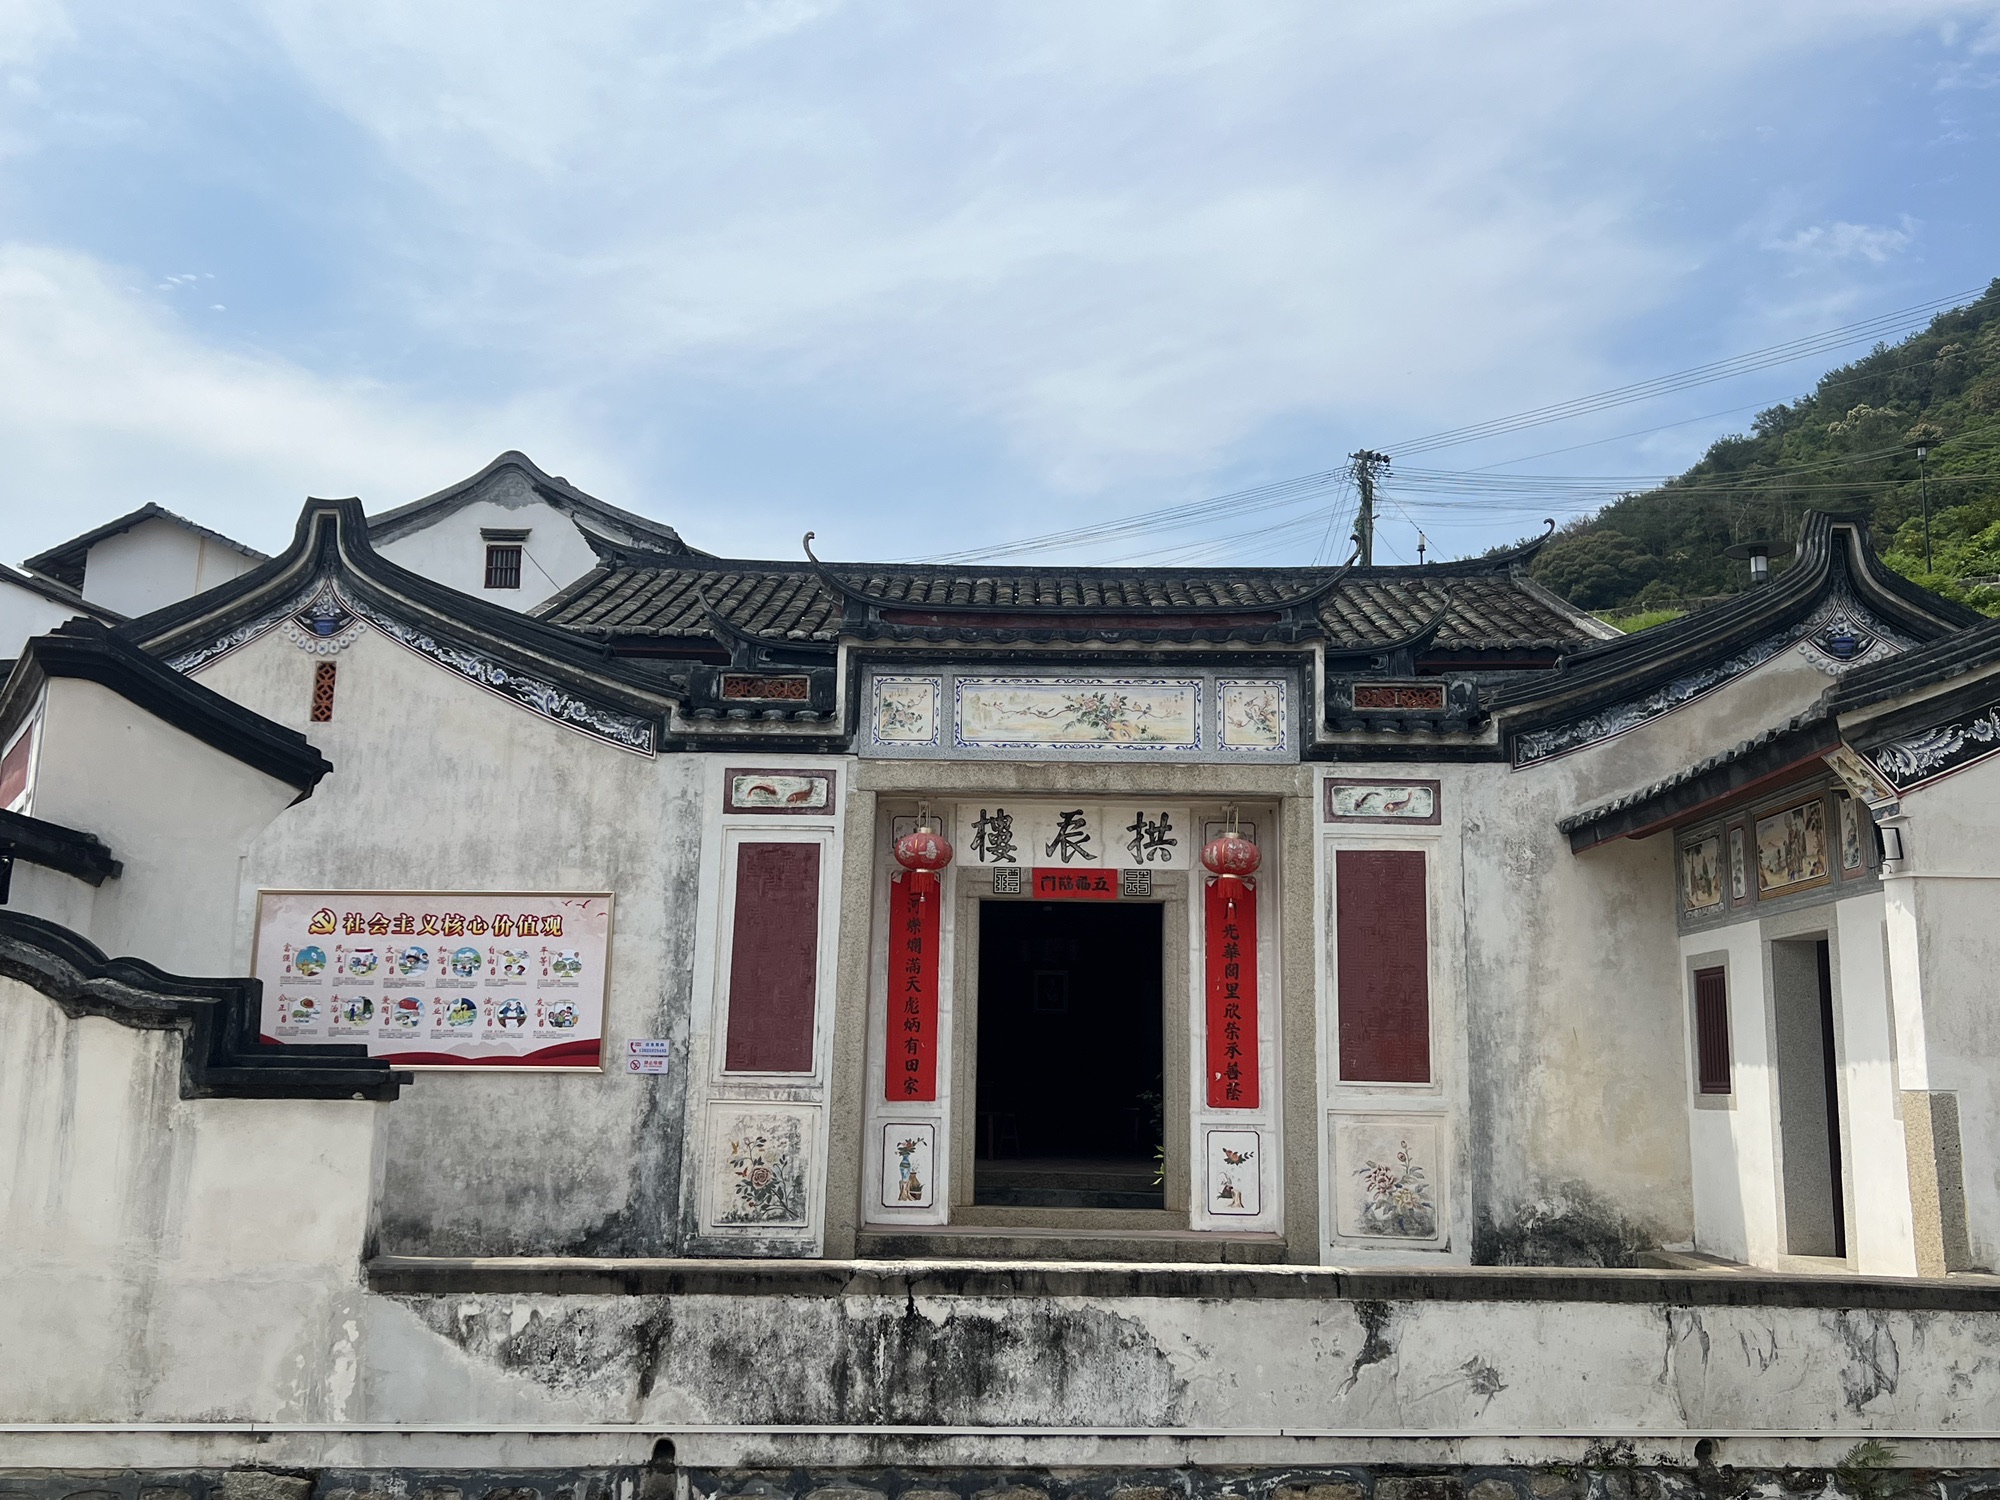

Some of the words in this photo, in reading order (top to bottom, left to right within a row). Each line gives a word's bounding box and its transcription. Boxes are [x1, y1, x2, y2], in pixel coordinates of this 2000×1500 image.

[1041, 874, 1110, 892] 五福臨門
[343, 912, 563, 937] 社会主义核心价值观
[334, 944, 343, 963] 民主
[385, 945, 395, 964] 文明
[487, 946, 495, 965] 自由
[539, 946, 548, 967] 平等
[903, 886, 922, 1095] 河燦爛滿天彪炳有田家
[277, 993, 287, 1011] 公正
